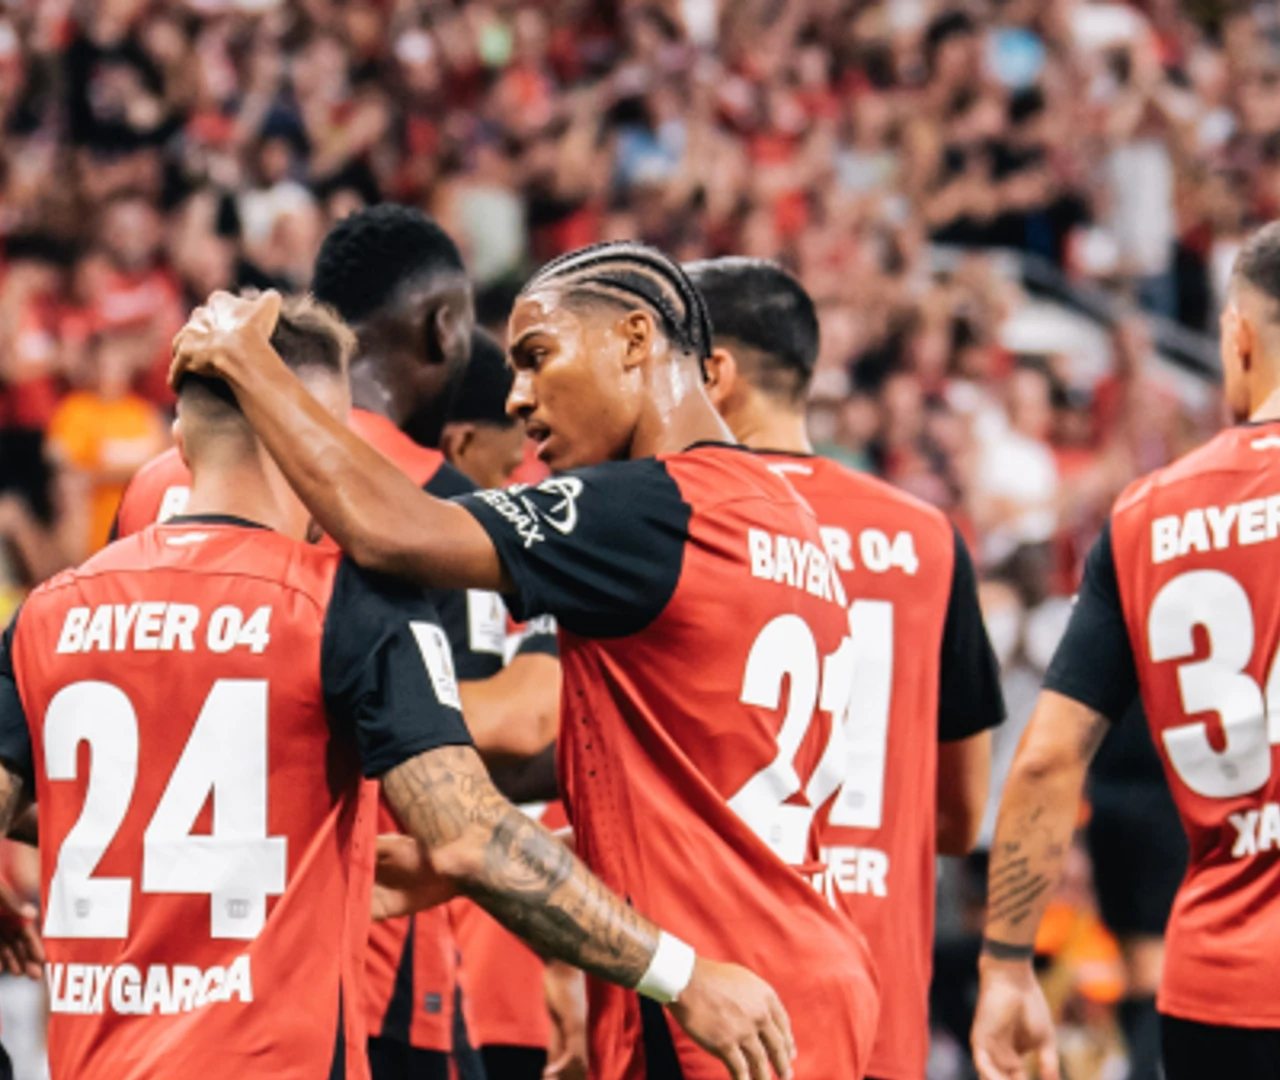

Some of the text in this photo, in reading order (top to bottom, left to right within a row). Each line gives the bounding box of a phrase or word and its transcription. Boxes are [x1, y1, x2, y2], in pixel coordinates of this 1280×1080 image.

[859, 529, 918, 575] 04
[57, 601, 272, 653] BAYER 04
[43, 679, 288, 939] 24
[110, 953, 253, 1014] GARCA
